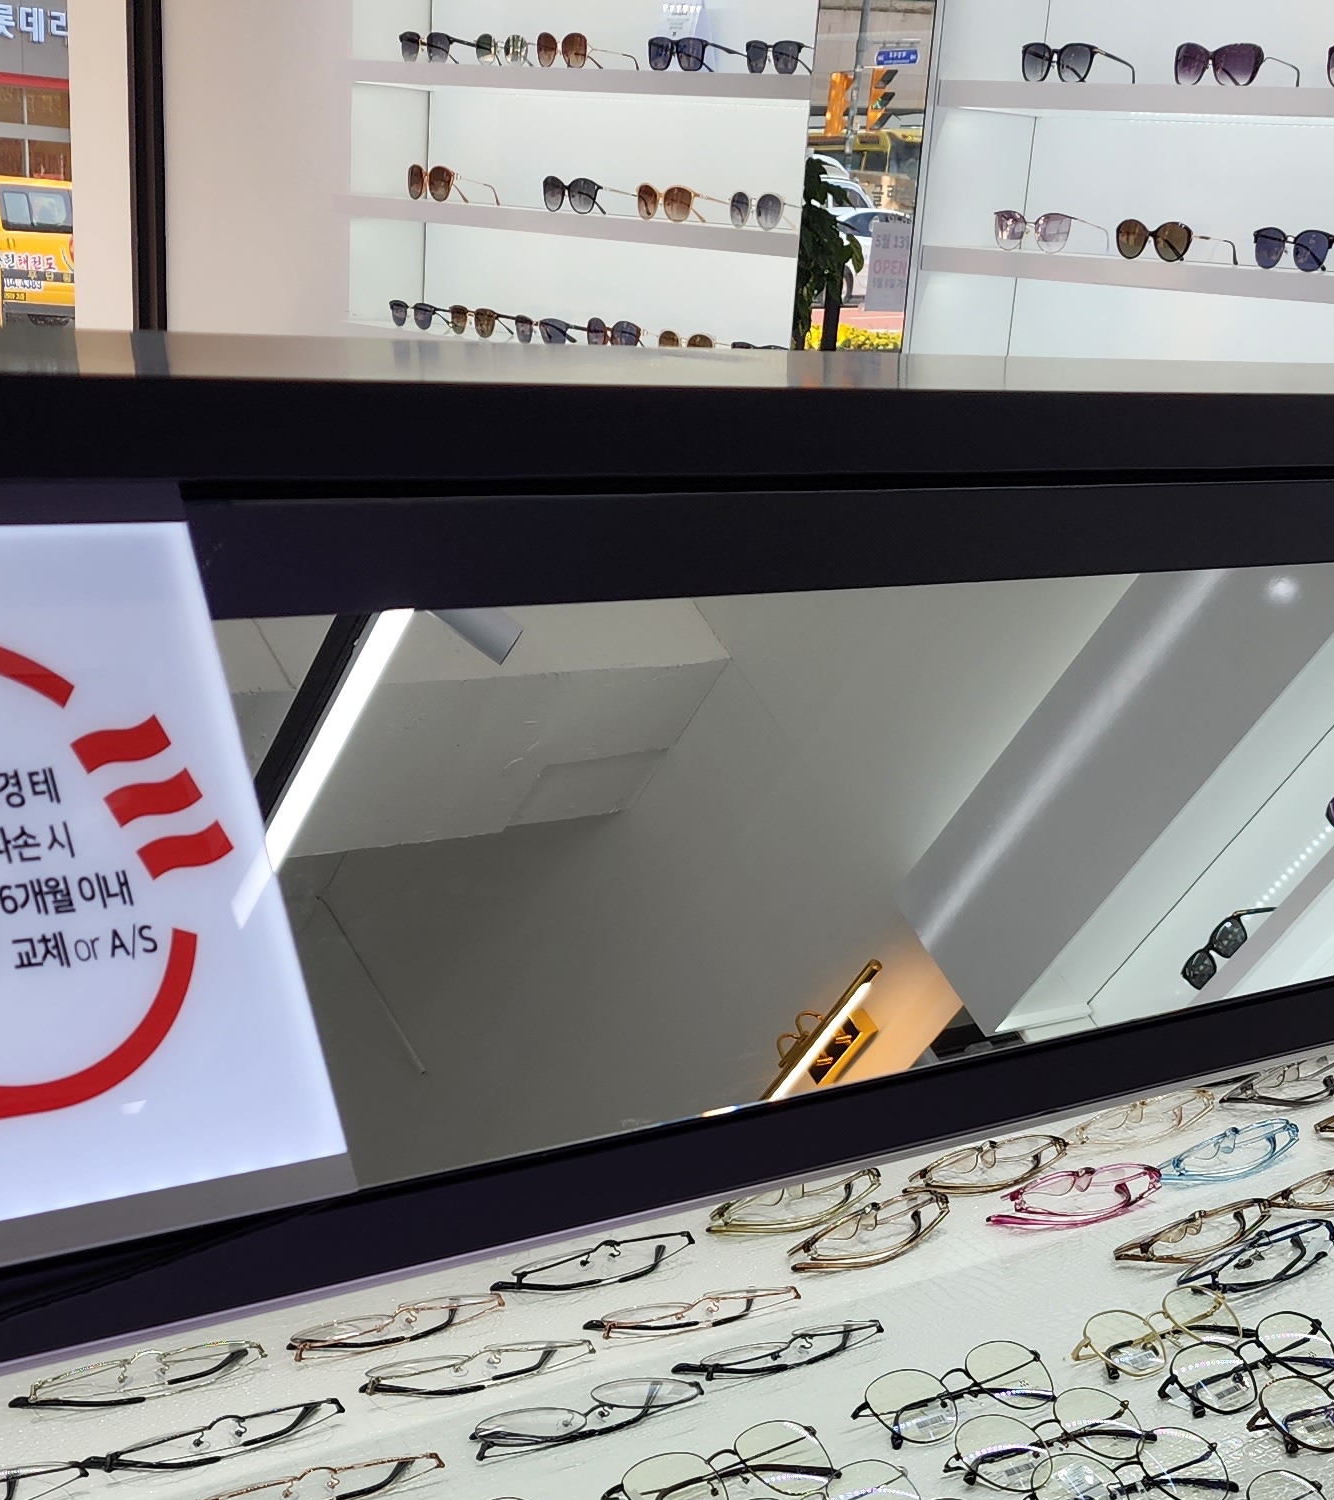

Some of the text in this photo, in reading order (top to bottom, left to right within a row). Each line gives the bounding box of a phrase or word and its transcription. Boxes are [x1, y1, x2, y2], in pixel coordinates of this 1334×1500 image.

[872, 257, 908, 276] OPEN
[46, 820, 76, 859] 시
[77, 869, 135, 908] 이내
[11, 923, 159, 970] 교체 or A/S
